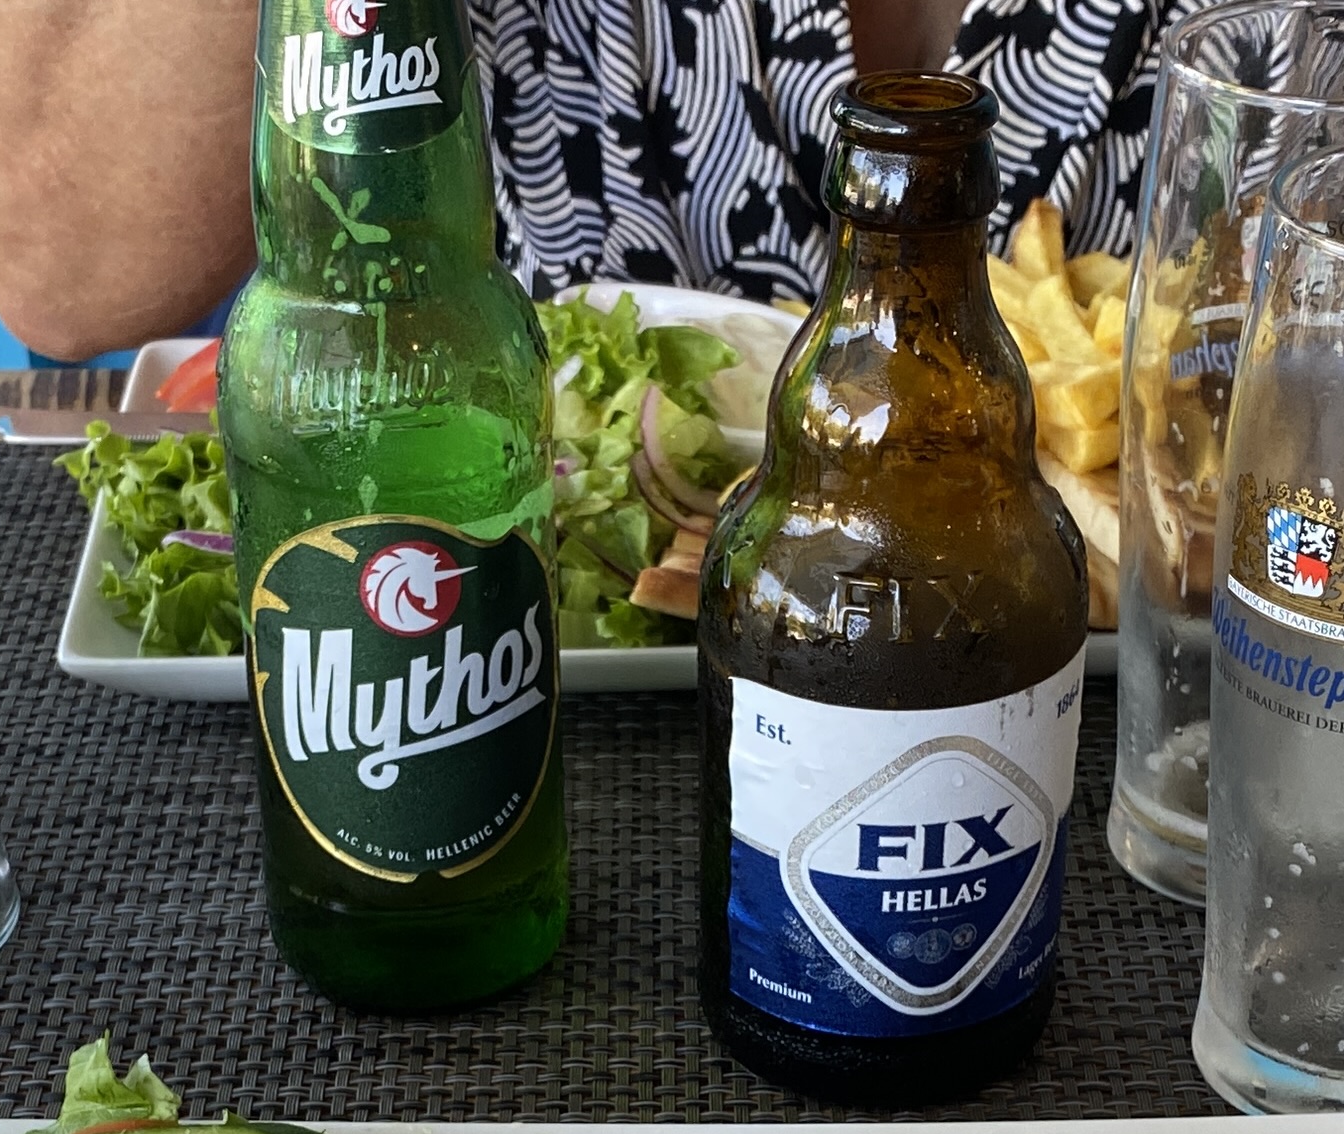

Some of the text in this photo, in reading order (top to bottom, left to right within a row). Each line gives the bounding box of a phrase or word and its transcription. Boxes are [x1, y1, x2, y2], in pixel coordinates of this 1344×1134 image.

[282, 31, 443, 136] Mythos
[826, 570, 992, 645] FIX
[282, 600, 546, 790] Mythos
[1246, 686, 1311, 727] BRAUEREI
[756, 713, 792, 746] Est.
[337, 793, 521, 862] ALC. 5% VOL. HELLENIC BEER
[856, 804, 1015, 872] FIX
[881, 878, 988, 913] HELLAS
[749, 967, 812, 1004] Premium
